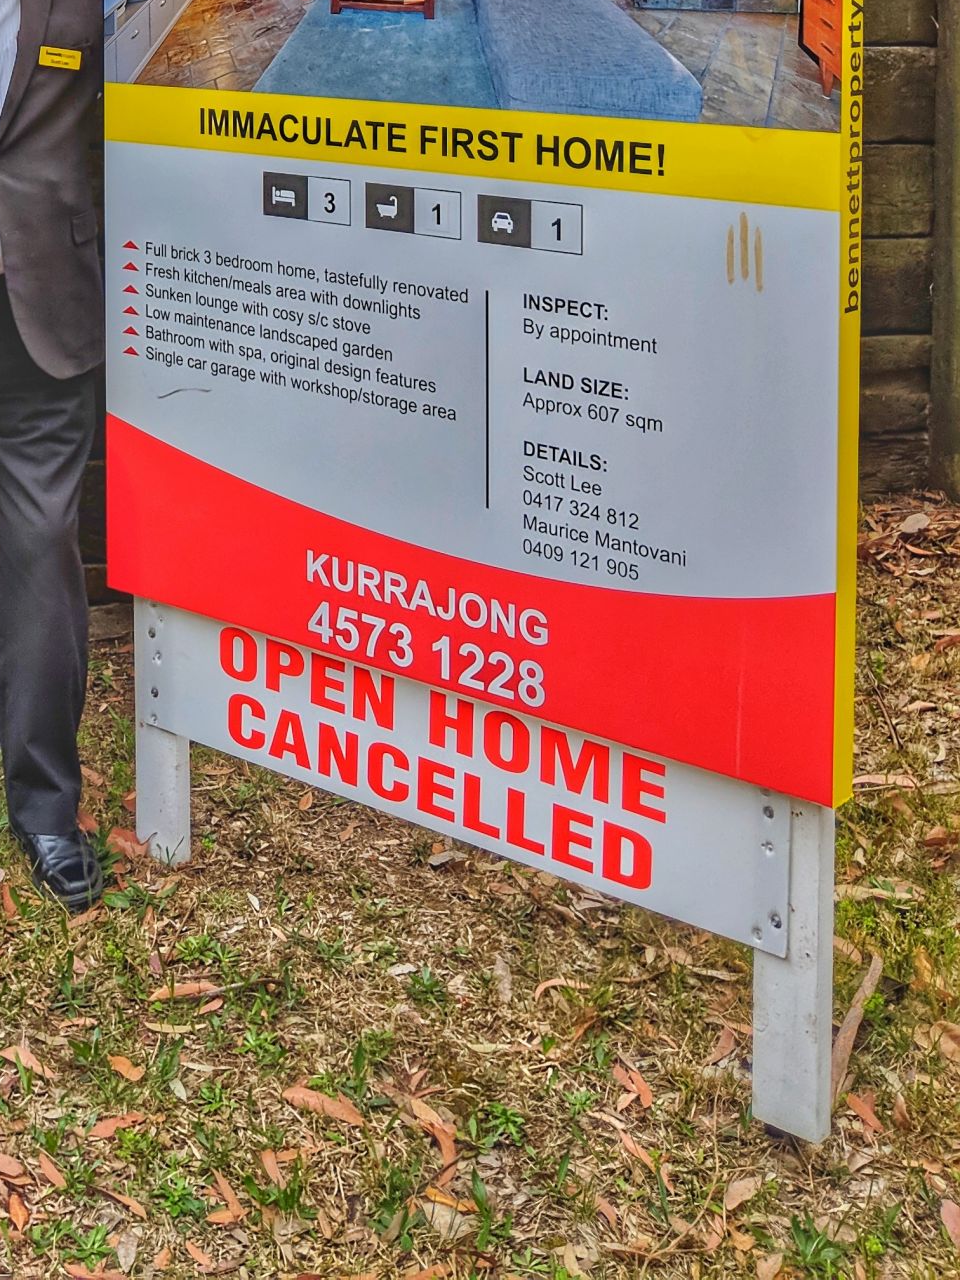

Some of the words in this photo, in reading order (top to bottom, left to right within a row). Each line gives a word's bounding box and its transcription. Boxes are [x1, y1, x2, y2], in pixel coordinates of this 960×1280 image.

[199, 107, 407, 154] IMMACULATE
[419, 125, 522, 164] FIRST
[536, 134, 666, 177] HOME!
[324, 192, 337, 215] 3
[431, 203, 442, 226] 1
[551, 218, 563, 242] 1
[145, 241, 167, 258] Full
[170, 245, 200, 263] brick
[203, 250, 212, 265] 3
[215, 252, 273, 274] bedroom
[277, 261, 320, 283] home,
[324, 268, 389, 295] tastefully
[392, 281, 470, 304] renovated
[145, 262, 180, 281] Fresh
[183, 268, 272, 295] kitchen/meals
[275, 286, 307, 302] area
[310, 289, 338, 307] with
[342, 294, 421, 321] downlights
[145, 283, 192, 304] Sunken
[195, 291, 238, 314] lounge
[242, 300, 268, 318] with
[272, 307, 304, 326] cosy
[308, 311, 329, 328] s/c
[332, 316, 371, 334] stove
[145, 304, 171, 321] Low
[174, 311, 256, 337] maintenance
[259, 323, 338, 352] landscaped
[342, 339, 393, 362] garden
[522, 293, 608, 321] INSPECT:
[145, 325, 205, 349] Bathroom
[208, 338, 235, 355] with
[238, 344, 267, 365] spa,
[270, 350, 320, 372] original
[324, 359, 372, 383] design
[375, 367, 437, 393] features
[523, 318, 545, 340] By
[549, 325, 658, 354] appointment
[145, 346, 184, 369] Single
[184, 355, 207, 370] car
[210, 359, 258, 384] garage
[260, 368, 288, 387] with
[291, 377, 418, 415] workshop/storage
[422, 403, 456, 421] area
[523, 367, 574, 390] LAND
[580, 377, 630, 401] SIZE:
[522, 392, 583, 418] Approx
[587, 403, 620, 424] 607
[625, 414, 663, 434] sqm
[523, 440, 608, 472] DETAILS:
[523, 465, 566, 489] Scott
[570, 475, 603, 496] Lee
[523, 489, 564, 513] 0417
[569, 499, 601, 521] 324
[606, 508, 640, 530] 812
[522, 538, 564, 562] 0409
[570, 550, 599, 571] 121
[606, 558, 640, 581] 905
[523, 513, 589, 544] Maurice
[595, 530, 687, 568] Mantovani
[306, 549, 549, 646] KURRAJONG
[308, 601, 413, 668] 4573
[431, 635, 546, 708] 1228
[219, 626, 396, 730] OPEN
[428, 689, 667, 824] HOME
[227, 693, 654, 891] CANCELLED
